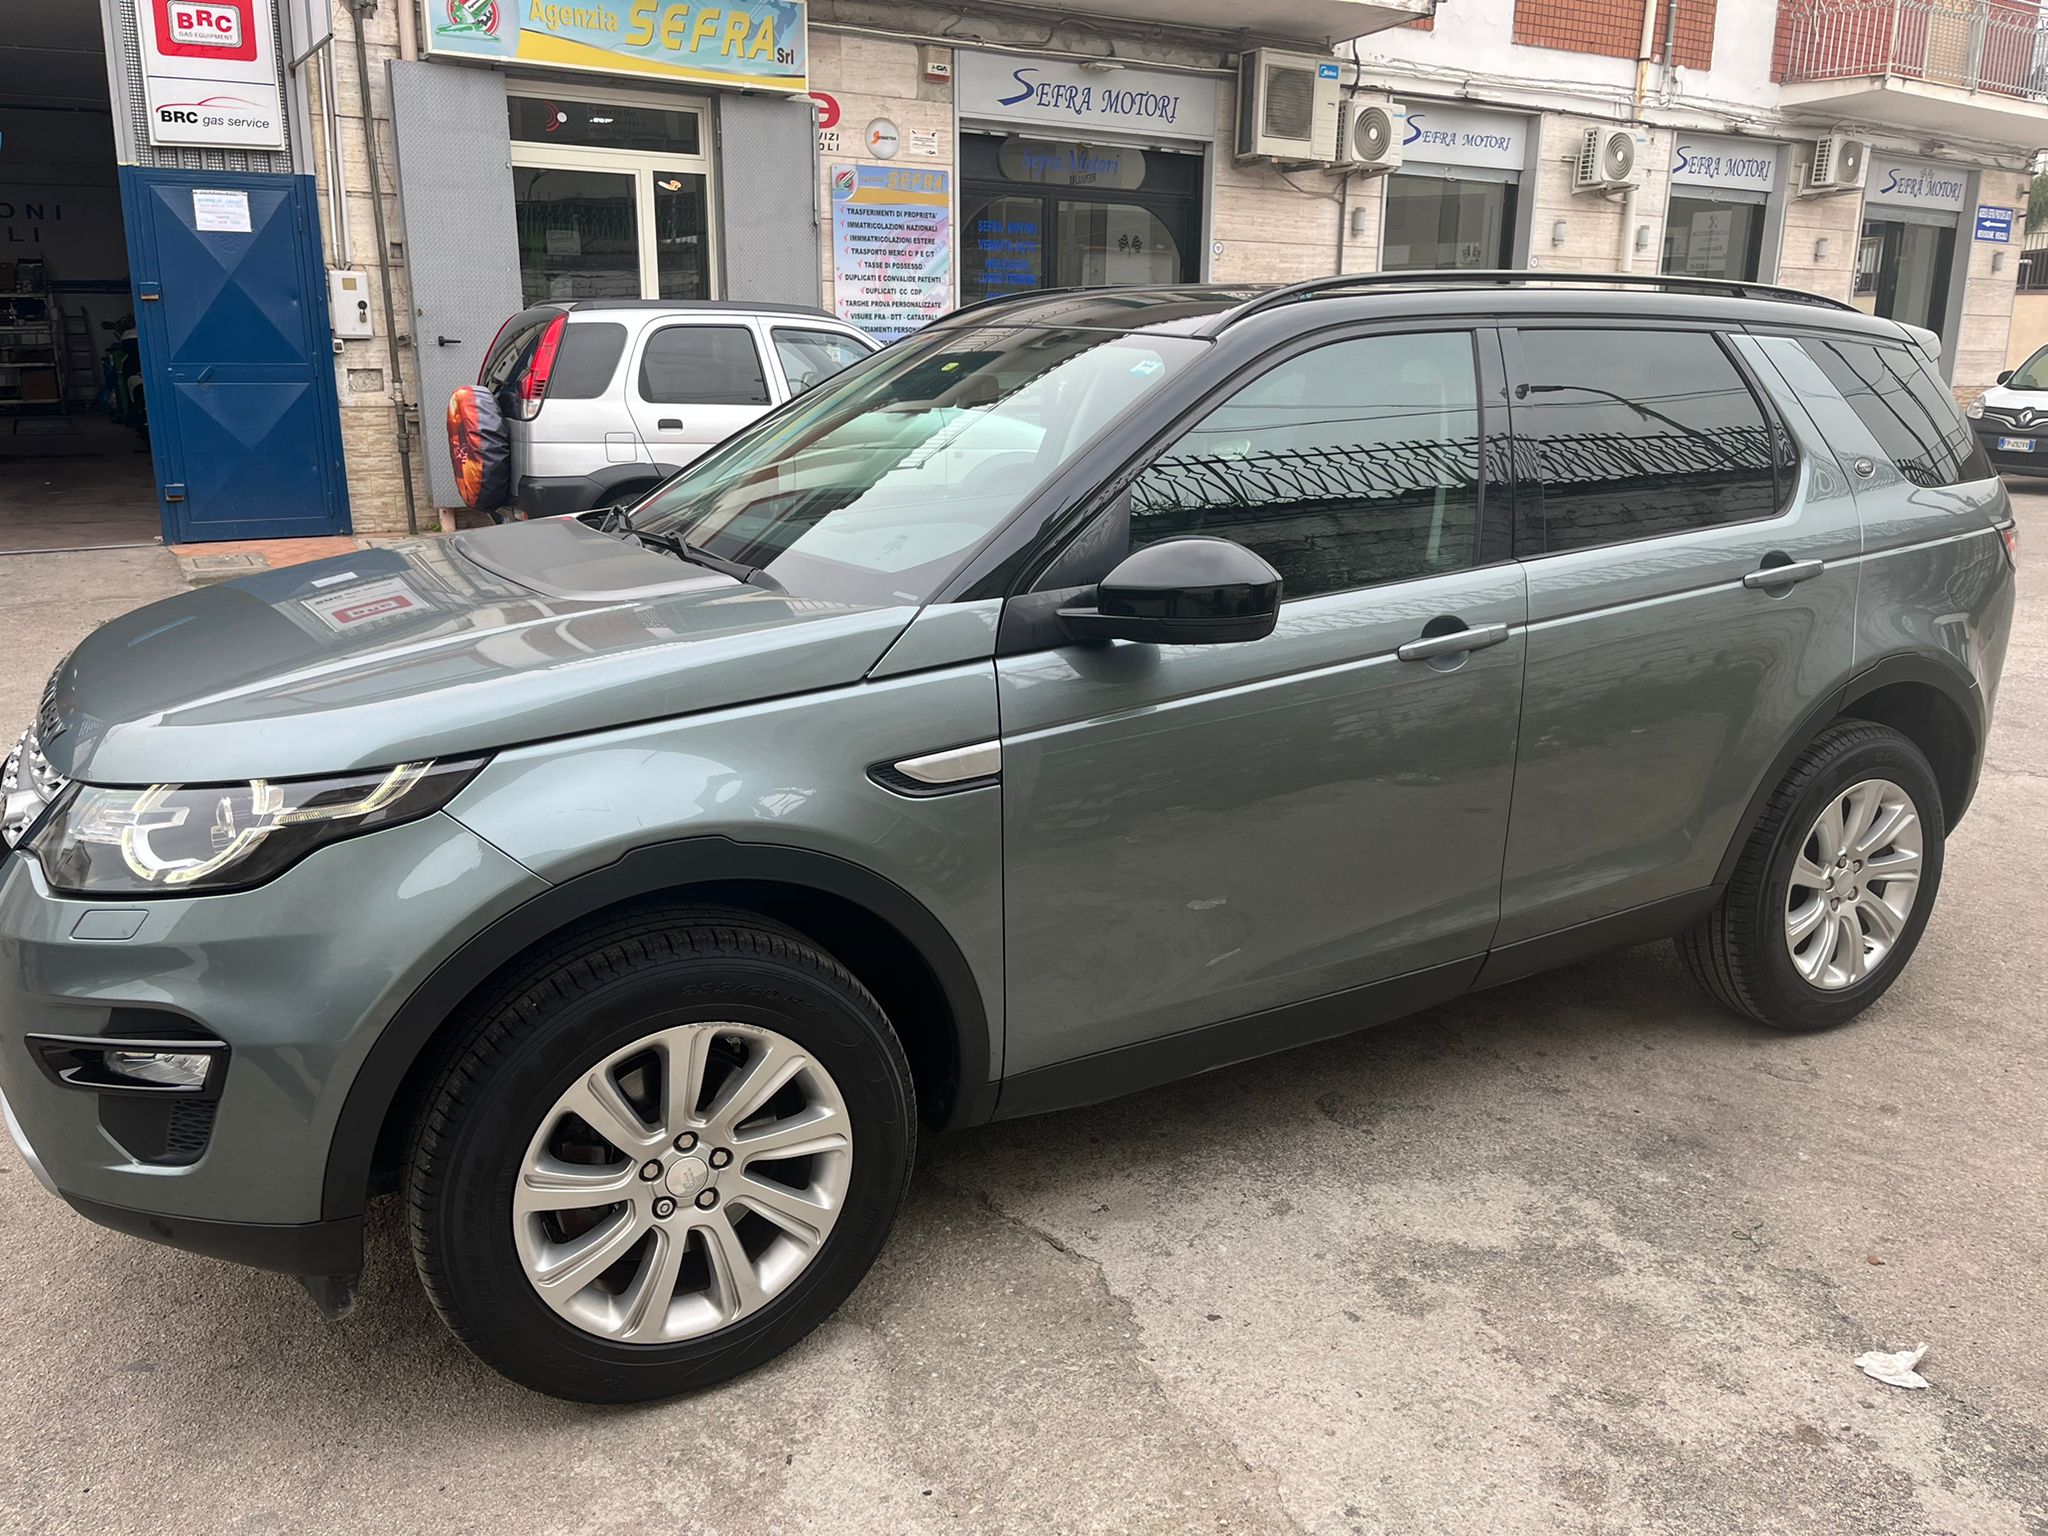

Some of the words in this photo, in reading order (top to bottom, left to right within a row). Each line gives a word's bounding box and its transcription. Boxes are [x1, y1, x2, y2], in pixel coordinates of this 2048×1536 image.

[176, 9, 233, 33] BRC
[194, 32, 233, 41] EQUIPMENT
[529, 0, 619, 32] Agenzia
[625, 0, 777, 62] SEFRA
[776, 47, 795, 65] Srl
[997, 68, 1093, 115] SEFRA
[1101, 88, 1180, 124] MOTORI
[160, 110, 199, 124] BRC
[202, 116, 224, 127] gas
[227, 117, 270, 129] service
[1403, 114, 1457, 147] SEFRA
[1462, 133, 1511, 152] MOTORI
[1672, 146, 1721, 179] SEFRA
[1724, 157, 1772, 182] MOTORI
[1880, 168, 1923, 198] SEFRA
[1925, 180, 1963, 202] MOTORI
[847, 208, 895, 217] TRASFERIMENTI
[903, 211, 938, 219] PROPRIETA'
[847, 221, 905, 231] IMMATRICOLAZIONI
[906, 224, 938, 232] NAZIONALI
[913, 237, 935, 245] ESTERE
[851, 248, 887, 256] TRASPORTO
[888, 249, 907, 257] MERCI
[864, 261, 883, 269] TASSE
[892, 262, 923, 270] POSSESSO
[883, 275, 916, 283] CONVALIDE
[865, 287, 897, 295] DUPLICATI
[845, 300, 869, 308] TARGHE
[891, 301, 942, 309] PERSONALIZZATE
[860, 326, 893, 334] NZIAMENTI
